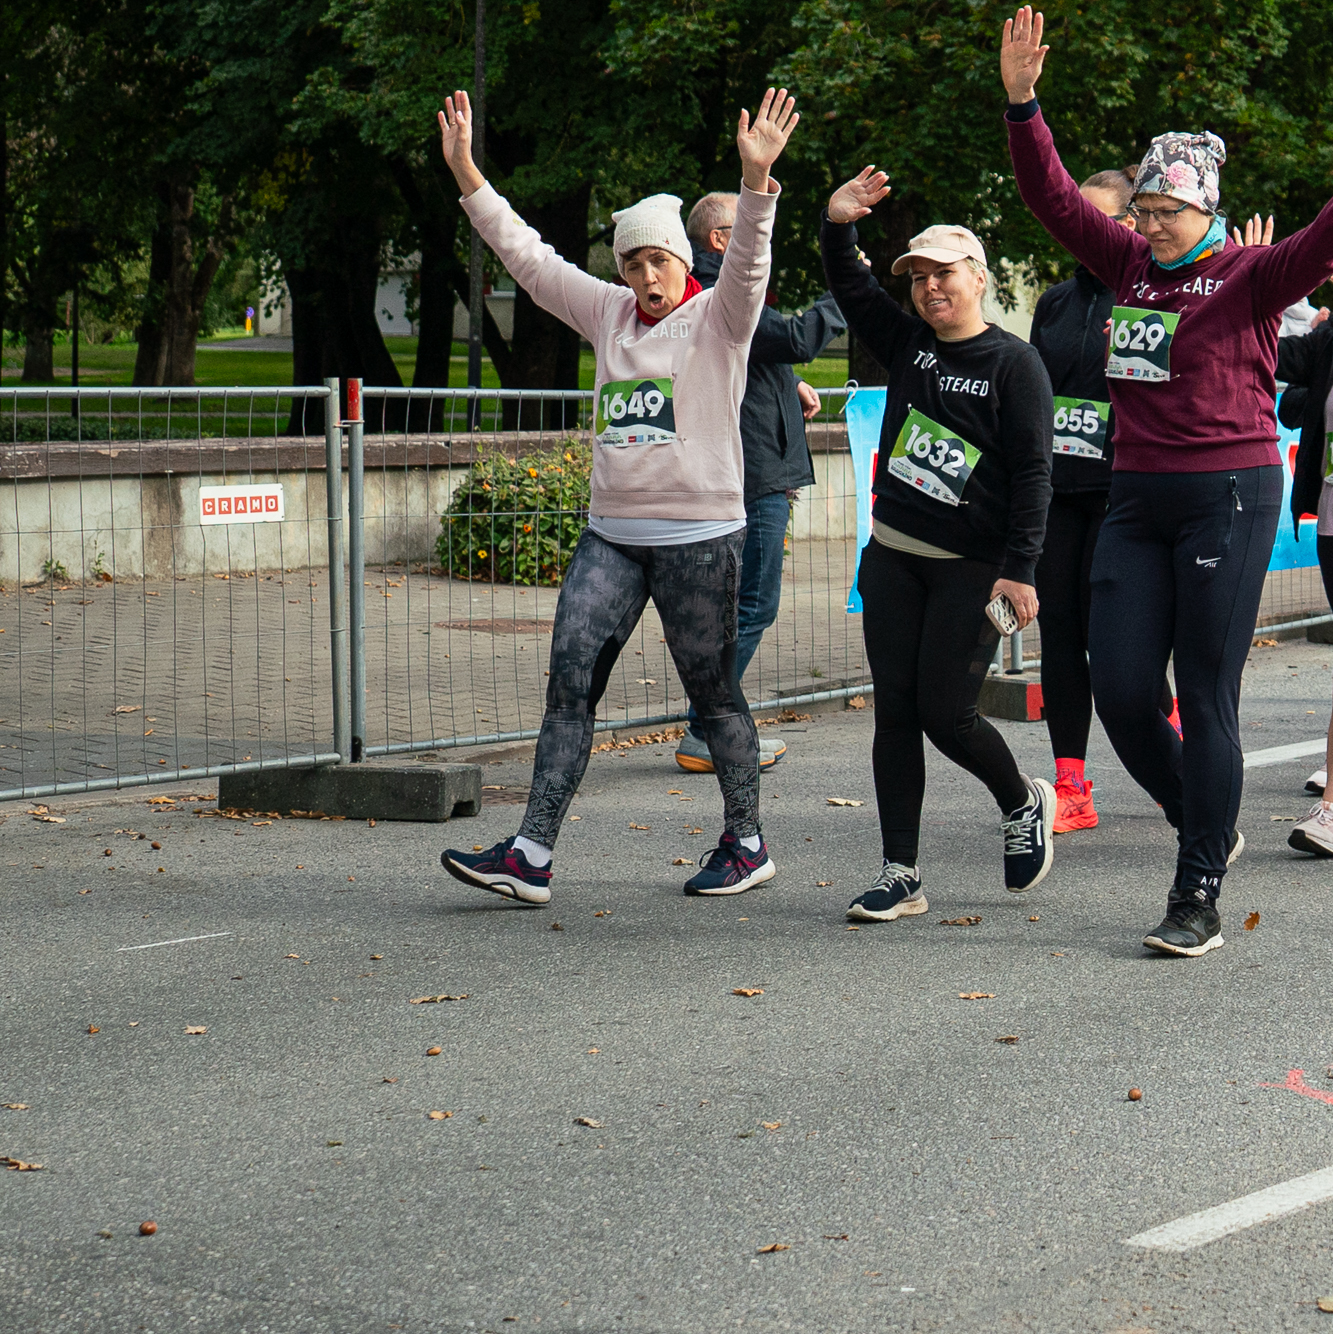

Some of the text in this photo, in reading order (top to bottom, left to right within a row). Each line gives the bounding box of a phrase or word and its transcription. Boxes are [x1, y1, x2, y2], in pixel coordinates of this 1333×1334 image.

[1110, 319, 1166, 351] 1629
[602, 389, 665, 421] 1649
[1053, 406, 1099, 434] 655
[905, 423, 966, 478] 1632
[204, 497, 277, 513] CRAMO
